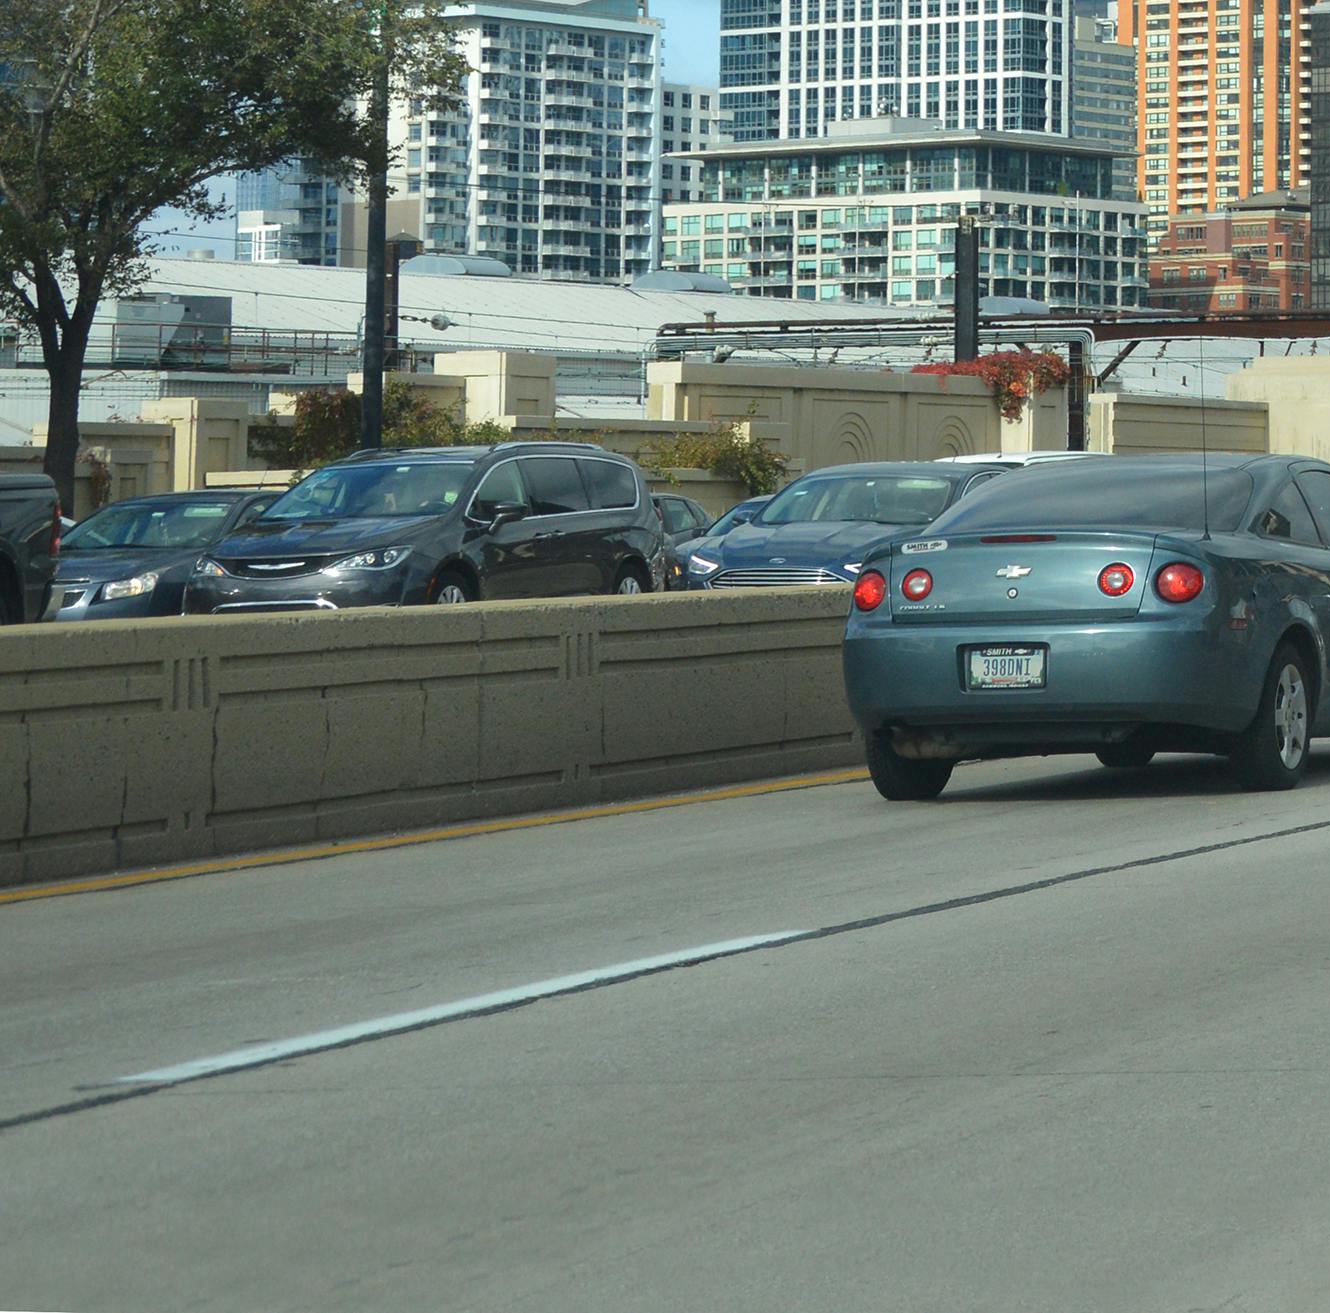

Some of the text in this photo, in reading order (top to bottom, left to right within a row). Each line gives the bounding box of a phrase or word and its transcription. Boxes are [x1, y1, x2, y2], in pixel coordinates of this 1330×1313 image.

[906, 542, 929, 550] SMITH
[986, 648, 1012, 656] SMITH
[983, 658, 1031, 676] 398DNI
